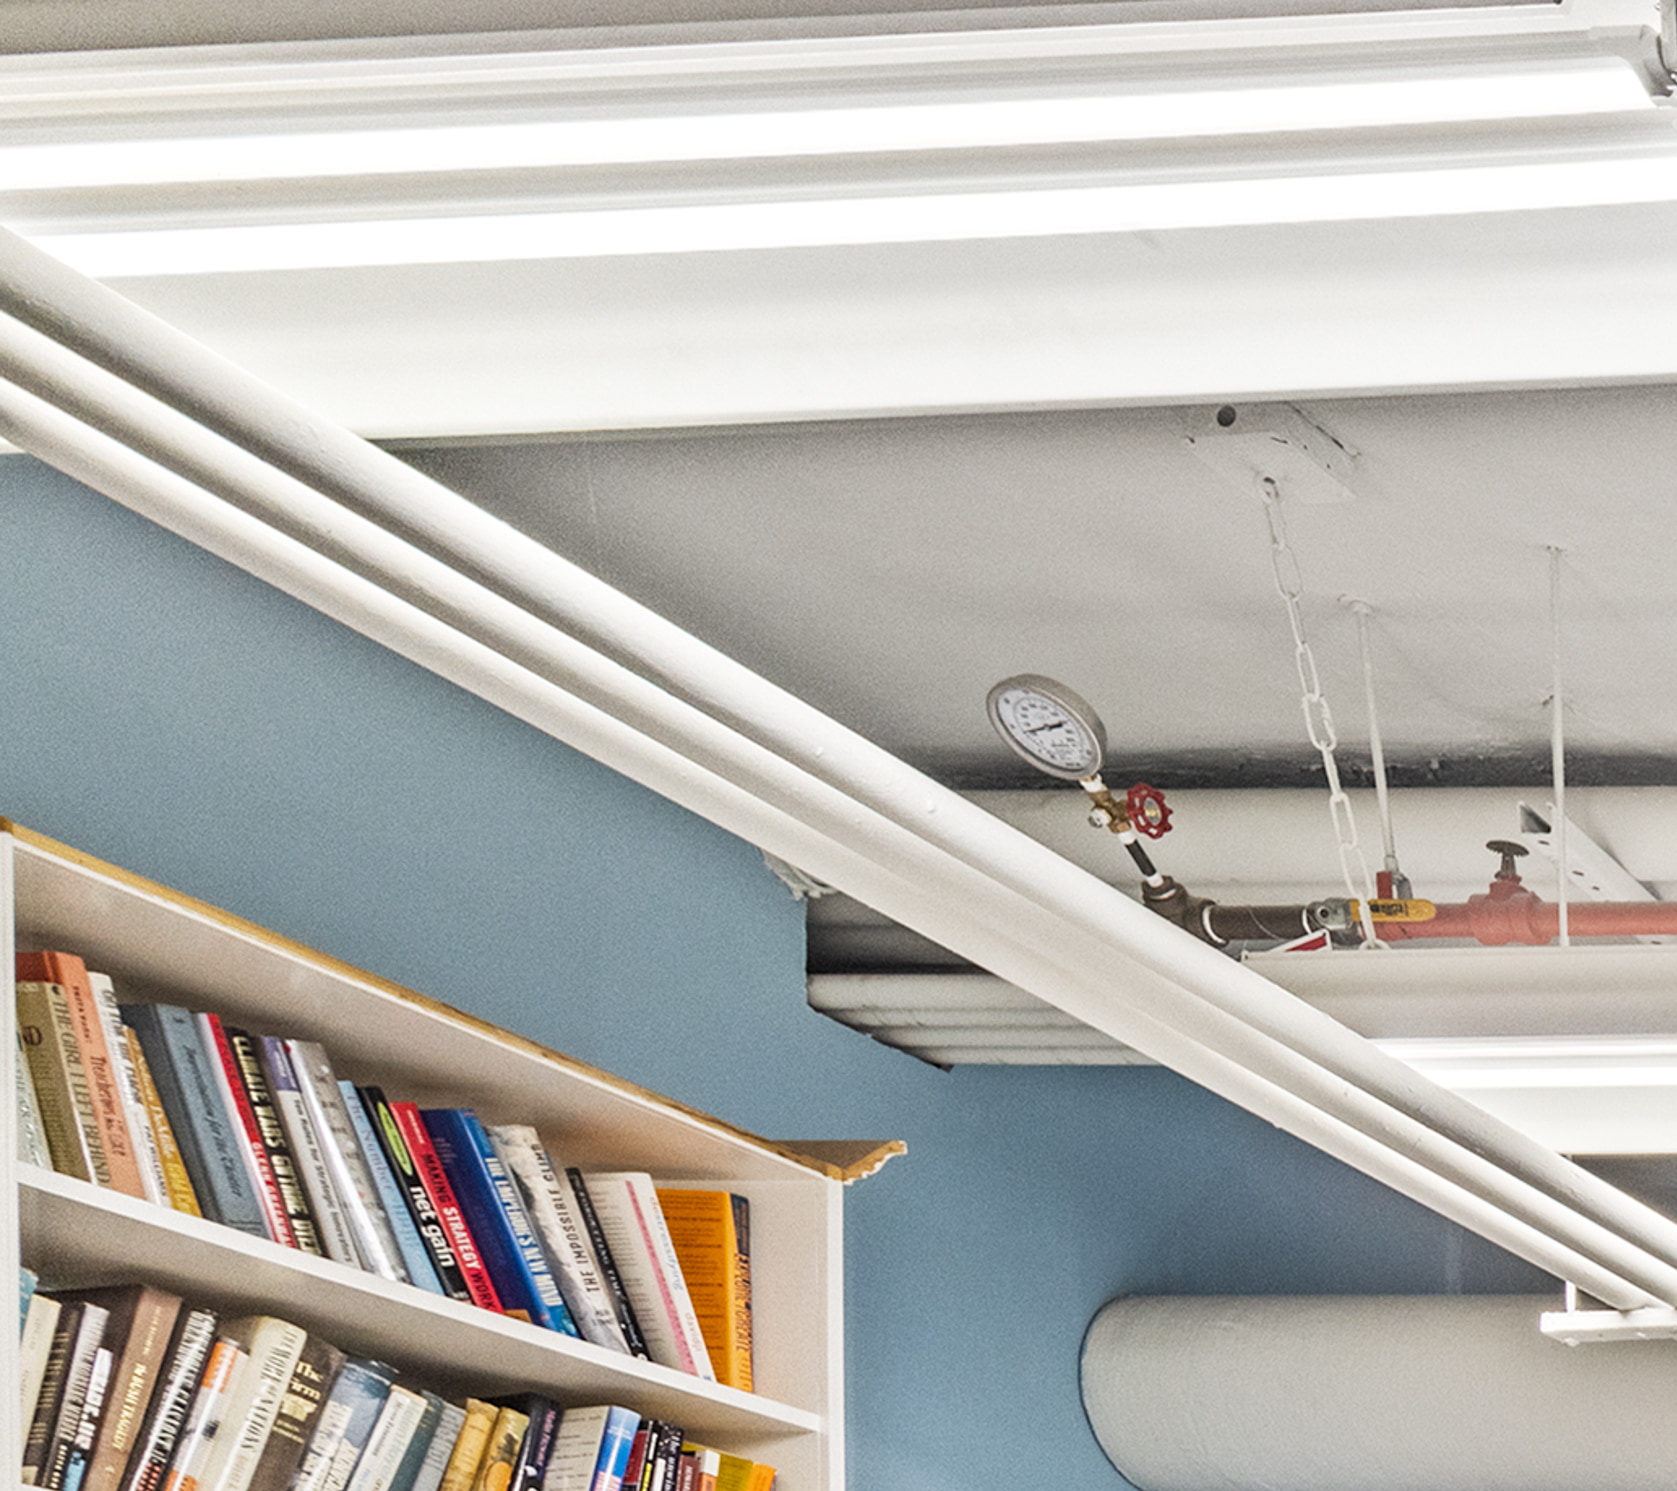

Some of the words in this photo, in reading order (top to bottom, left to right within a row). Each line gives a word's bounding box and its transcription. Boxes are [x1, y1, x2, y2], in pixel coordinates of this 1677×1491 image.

[232, 1036, 268, 1103] CLIMATE
[254, 1106, 286, 1148] WARS
[410, 1187, 435, 1225] net
[422, 1154, 450, 1202] MAKING
[443, 1207, 481, 1270] STRATEGY
[471, 1271, 498, 1309] WORK
[552, 1188, 589, 1267] IMPOSSIBLE
[422, 1225, 455, 1267] gain
[581, 1270, 600, 1293] THE
